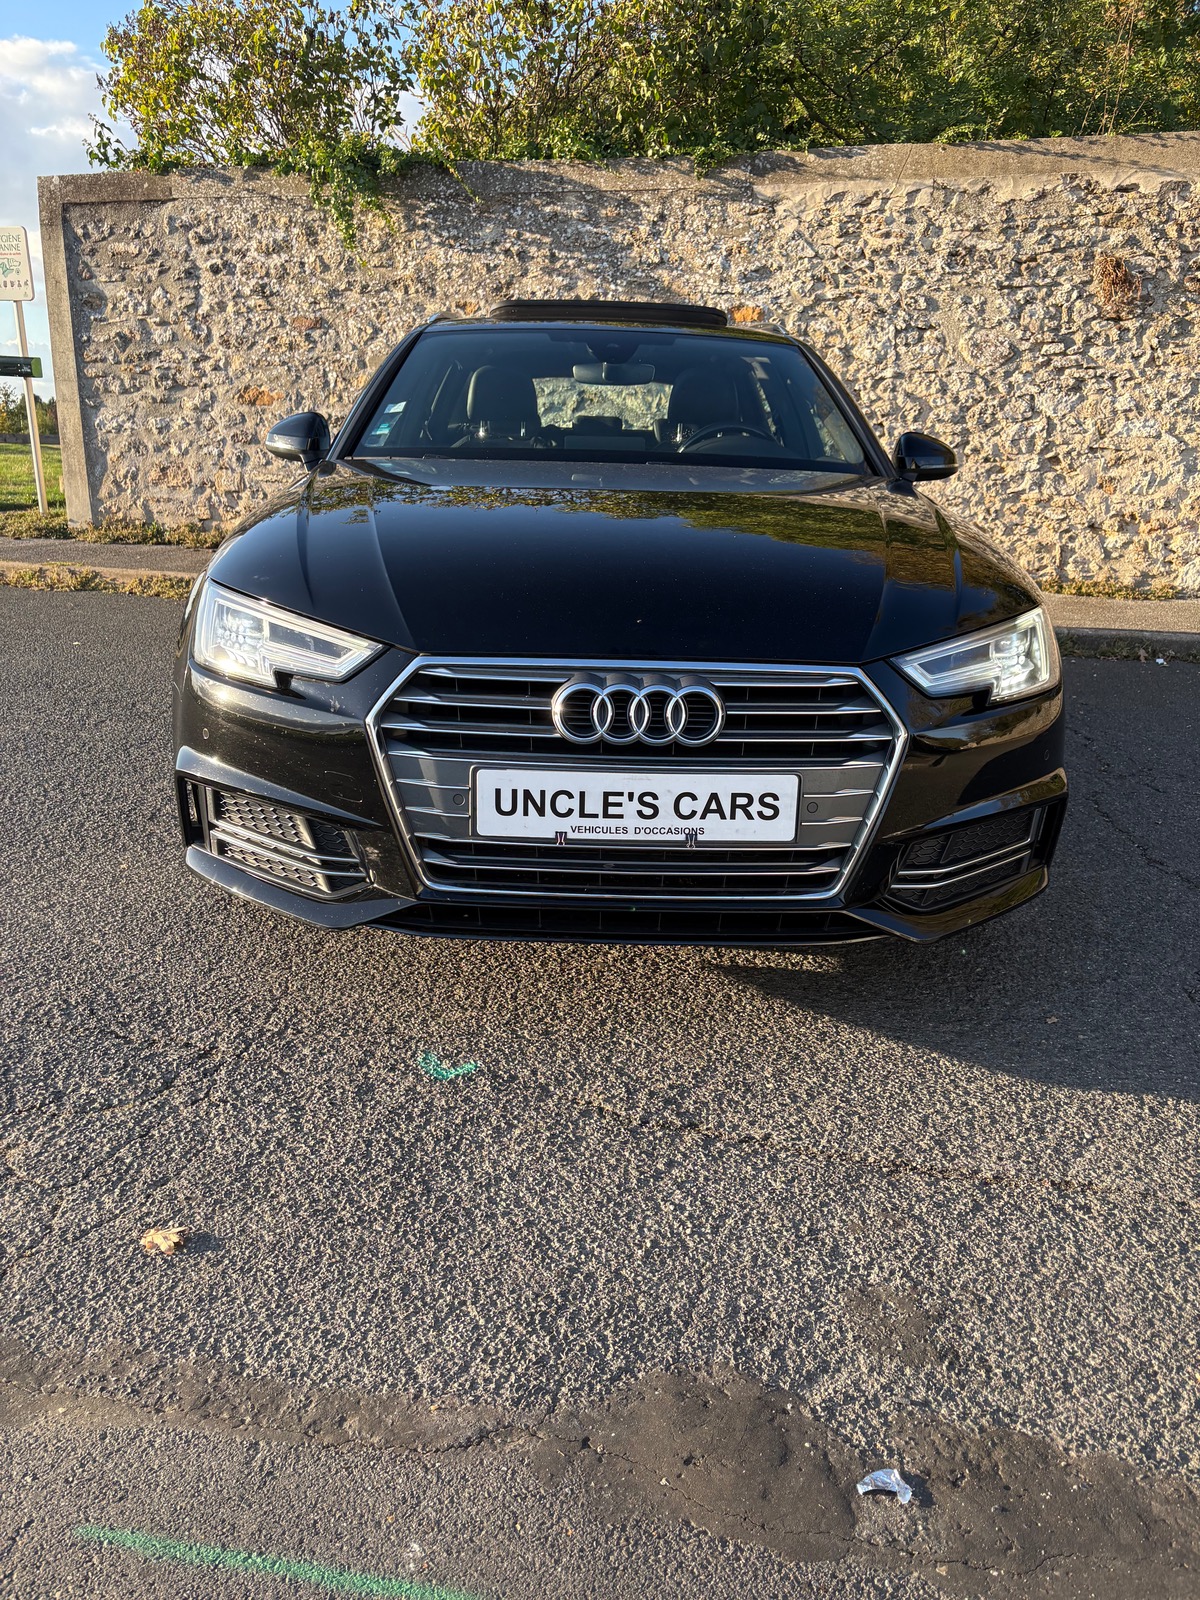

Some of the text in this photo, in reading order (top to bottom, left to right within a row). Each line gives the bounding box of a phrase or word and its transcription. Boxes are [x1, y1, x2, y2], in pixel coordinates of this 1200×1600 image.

[0, 233, 21, 242] GIÈNE
[494, 788, 780, 821] UNCLE'S CARS
[570, 825, 705, 836] VEHICULES D'OCCASIONS
